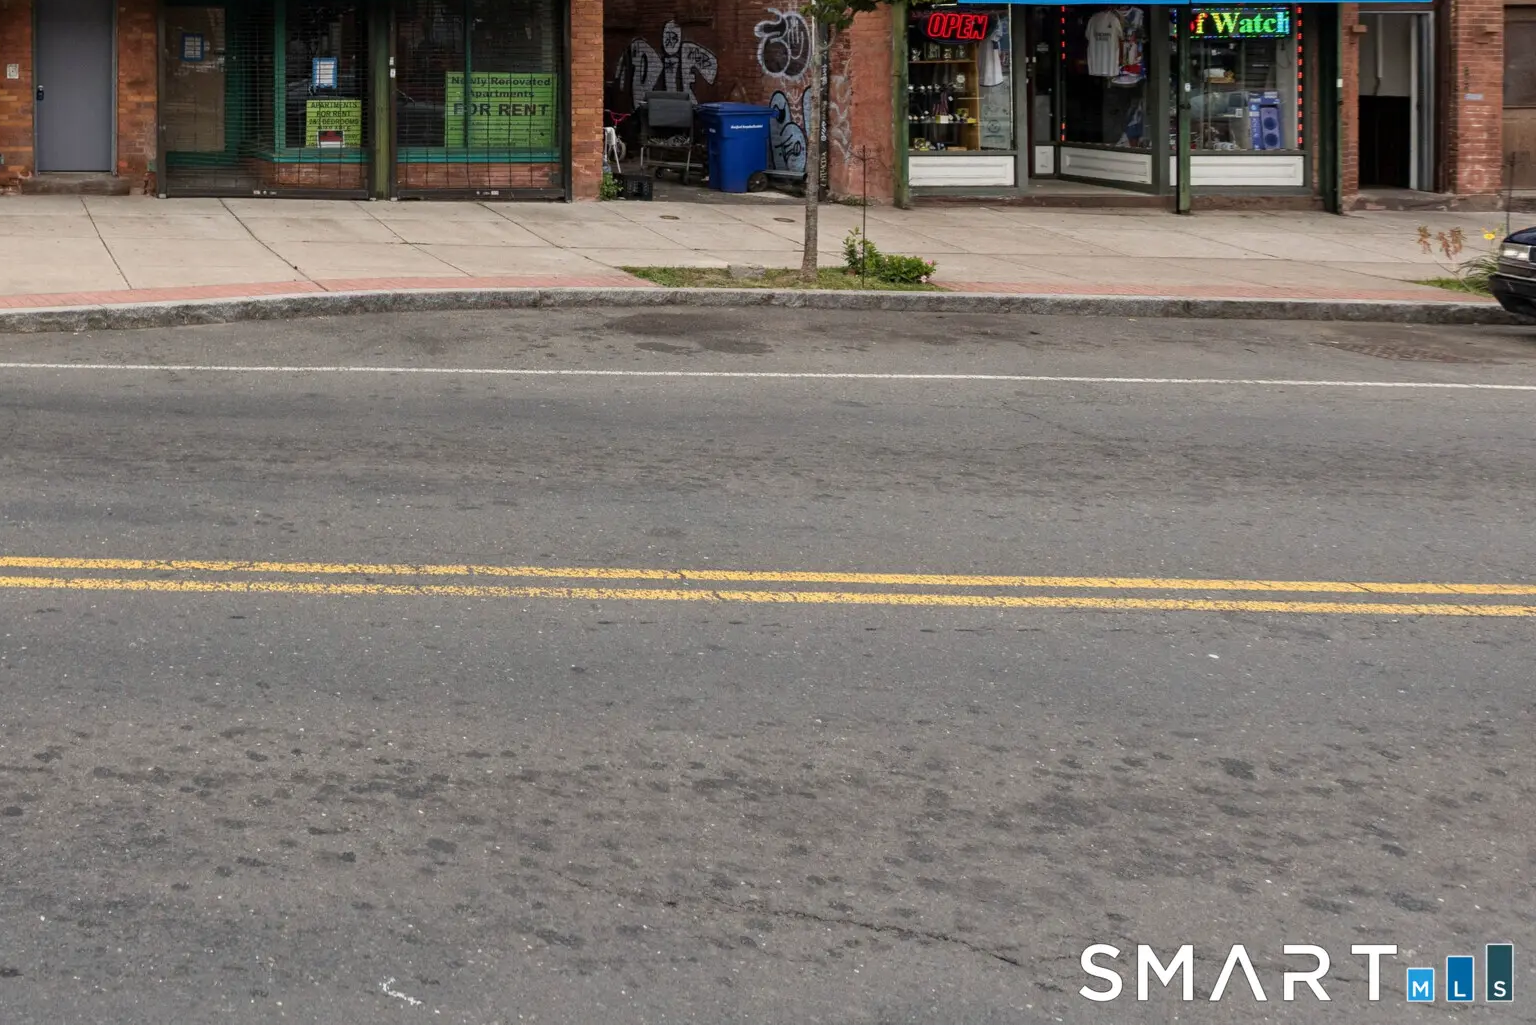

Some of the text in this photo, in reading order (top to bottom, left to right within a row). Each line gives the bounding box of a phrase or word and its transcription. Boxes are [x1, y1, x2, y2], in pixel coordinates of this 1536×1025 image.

[927, 12, 989, 40] OPEN
[491, 77, 551, 86] Renovated
[454, 103, 549, 116] FOR RENT
